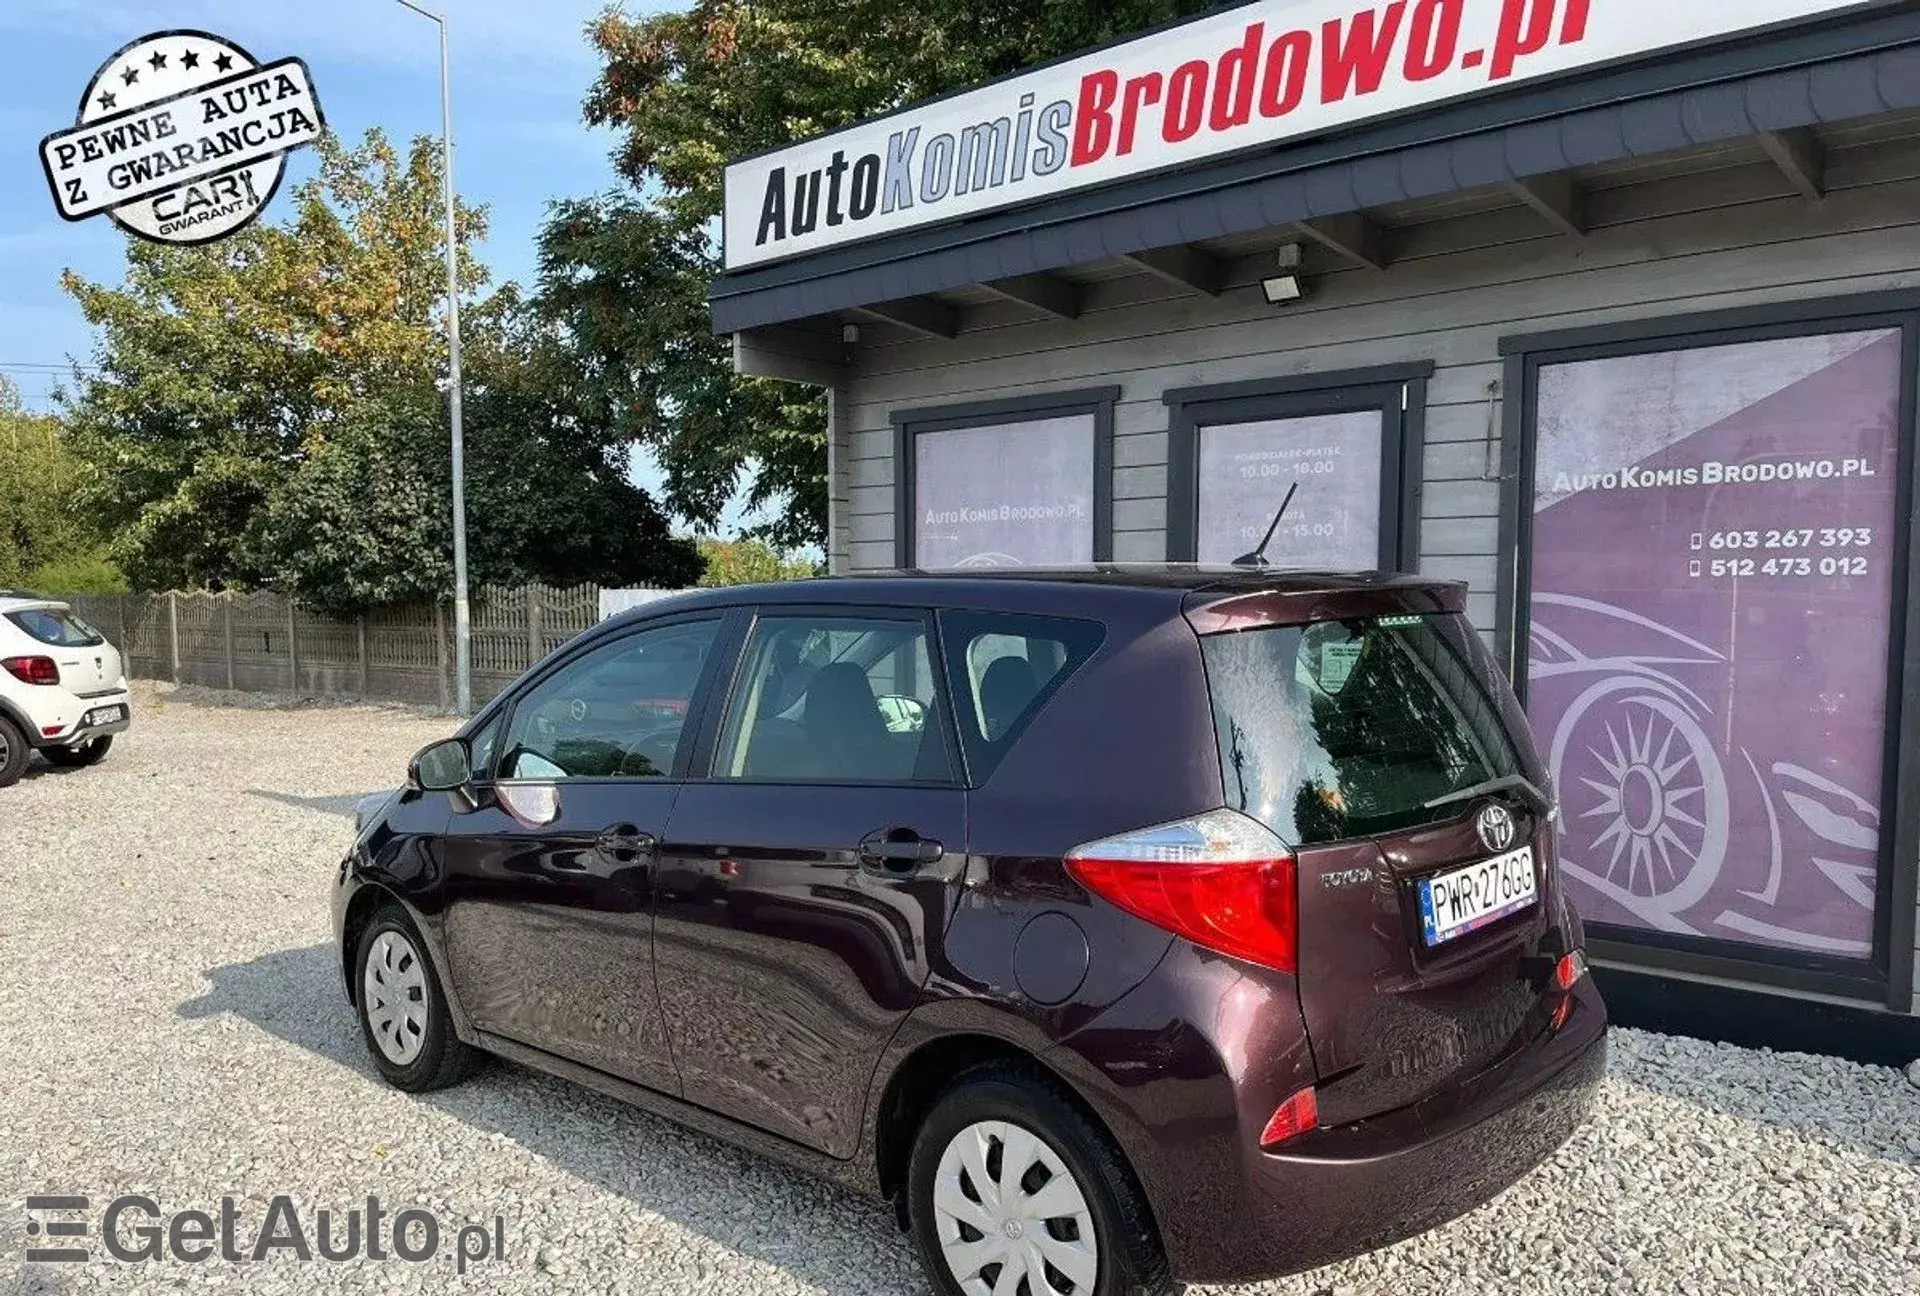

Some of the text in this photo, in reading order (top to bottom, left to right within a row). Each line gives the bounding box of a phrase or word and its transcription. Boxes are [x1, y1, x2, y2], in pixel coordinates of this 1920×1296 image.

[1708, 527, 1872, 550] 603 267 393
[1710, 556, 1868, 577] 512 473 012
